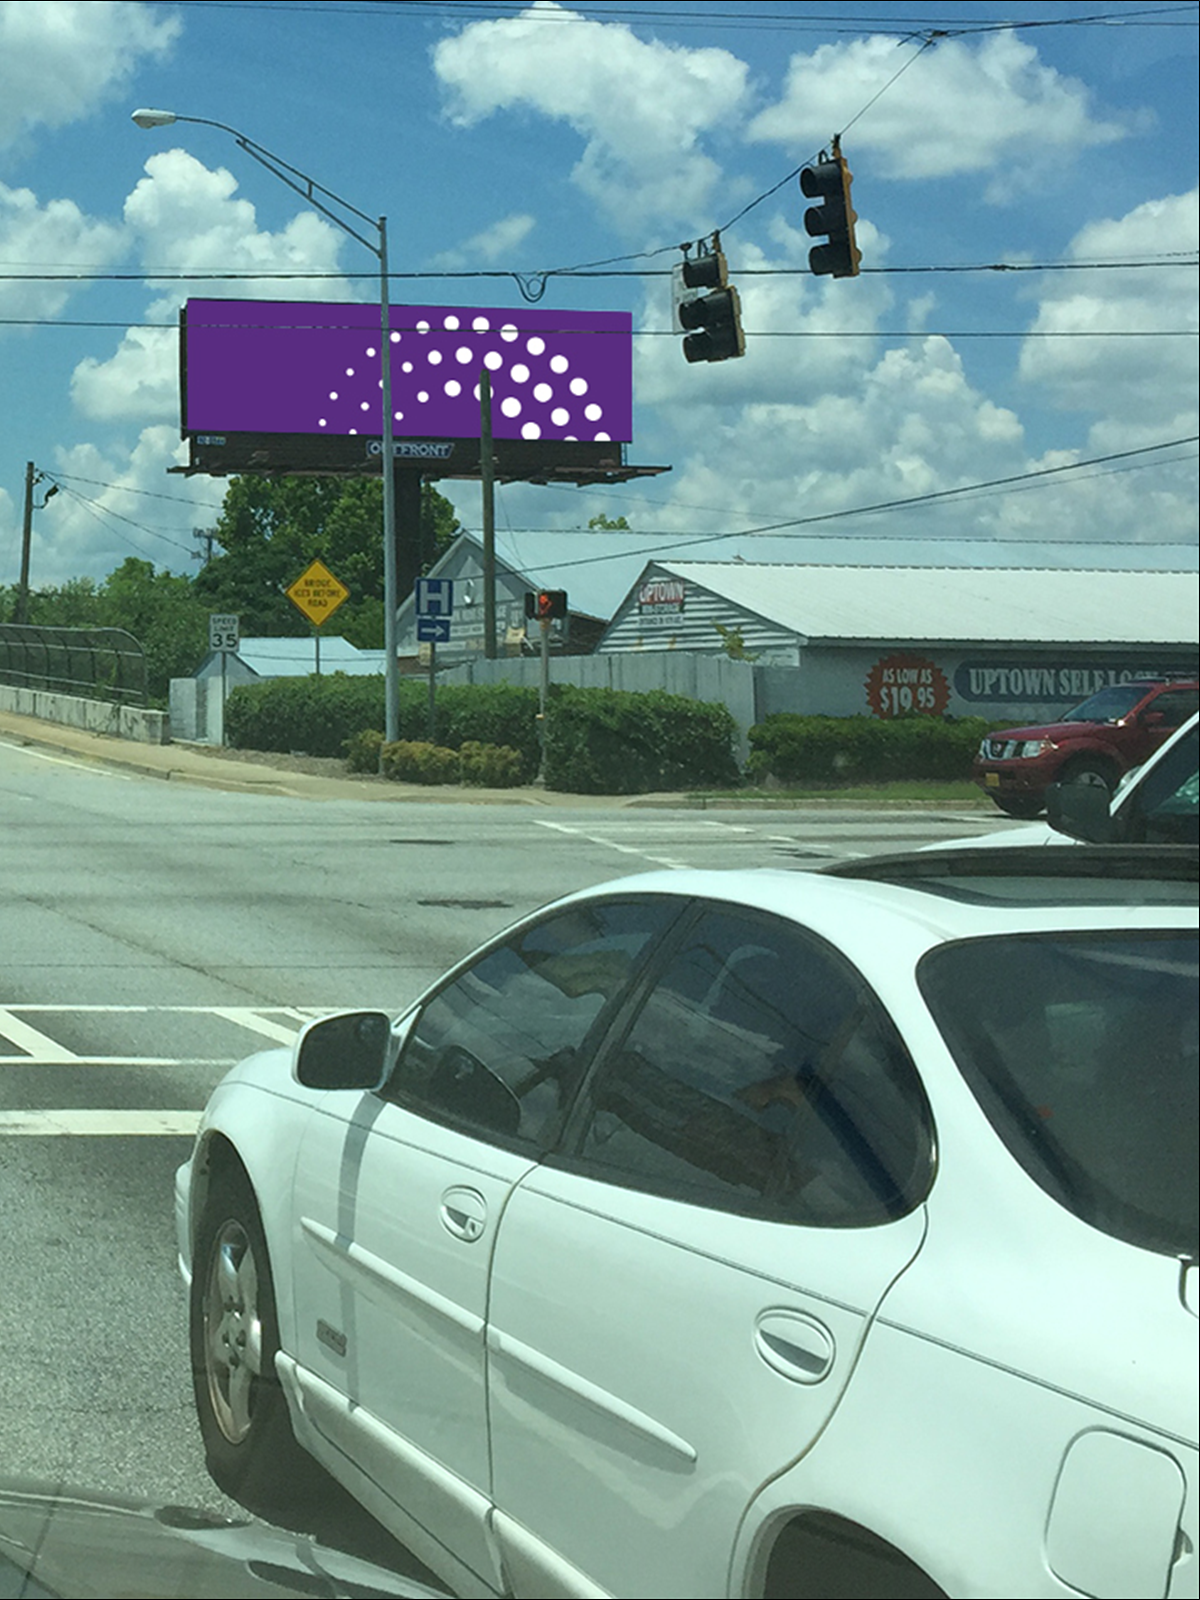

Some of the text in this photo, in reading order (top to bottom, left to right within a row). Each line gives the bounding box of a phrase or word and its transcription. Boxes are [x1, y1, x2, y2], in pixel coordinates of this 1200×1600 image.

[370, 441, 450, 457] OTFRONT
[419, 580, 450, 614] H
[640, 582, 684, 602] UPTOWN
[212, 617, 237, 625] SPEED
[212, 633, 238, 648] 35
[883, 668, 933, 684] AS LOW AS
[969, 667, 1054, 696] UPTOWN
[1058, 668, 1105, 697] SELF
